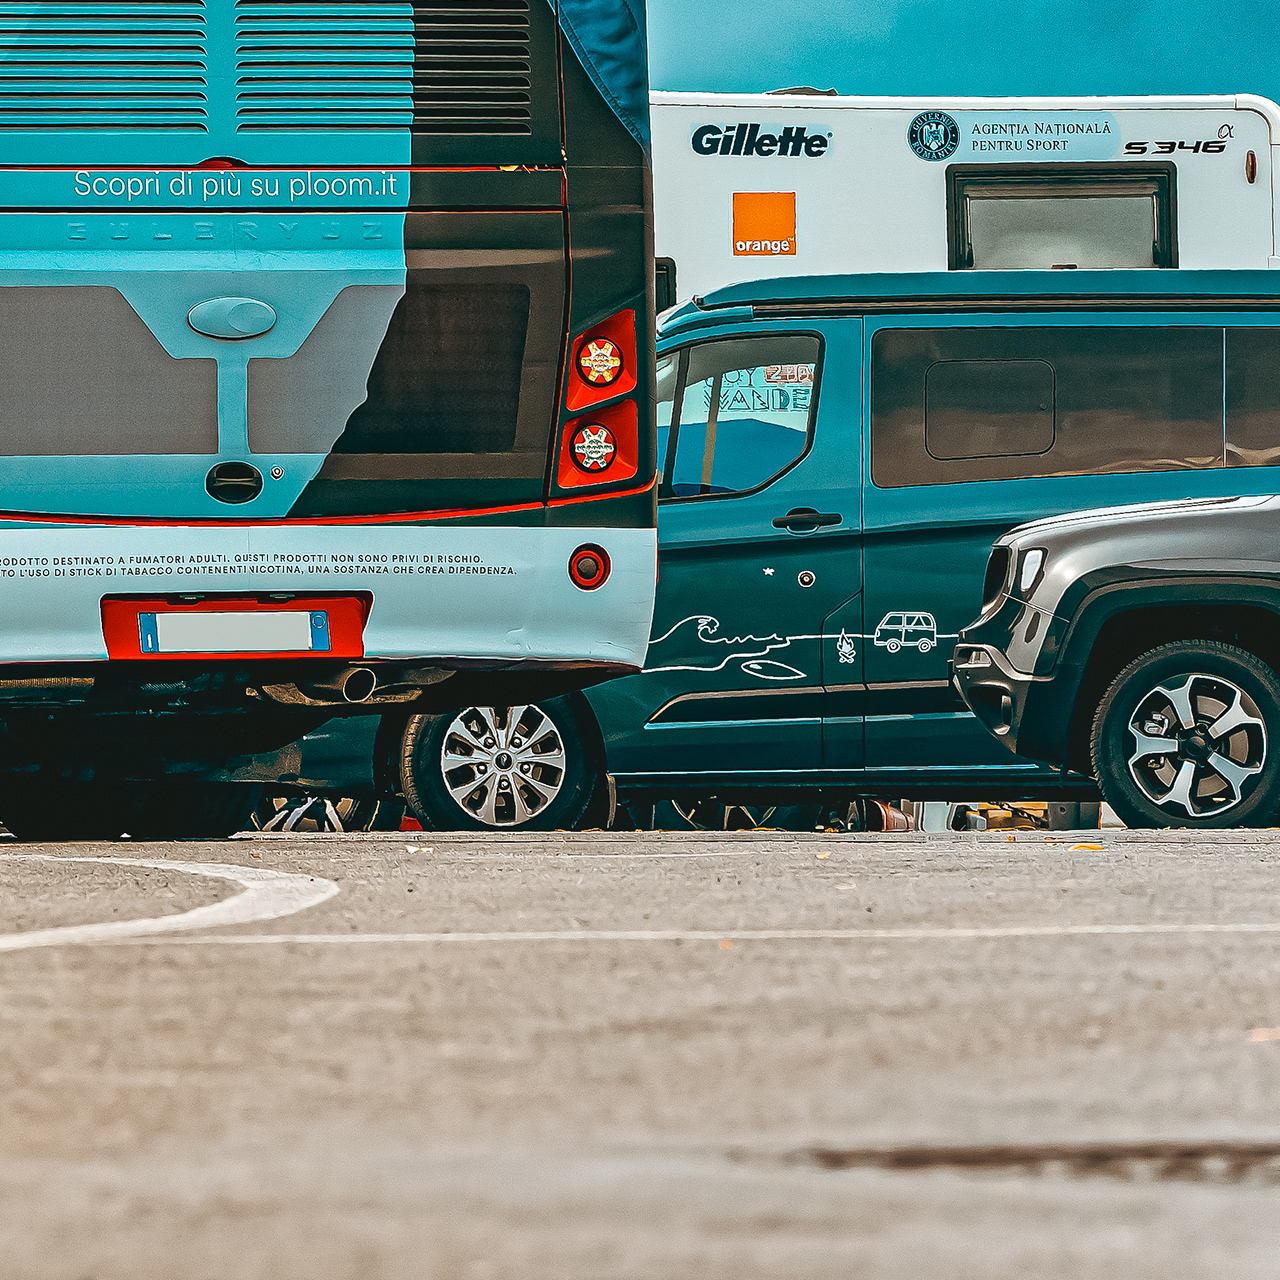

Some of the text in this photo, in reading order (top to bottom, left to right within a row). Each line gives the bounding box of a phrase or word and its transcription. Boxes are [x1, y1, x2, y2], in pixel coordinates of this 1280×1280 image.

[691, 122, 828, 157] Gillette
[73, 170, 398, 202] Scopri di più su ploom.it
[735, 240, 790, 254] orange
[52, 556, 114, 566] DESTINATO
[118, 556, 125, 565] A
[129, 555, 185, 565] FUMATORI
[189, 554, 230, 564] ADULTI.
[234, 554, 269, 563] QUESTI
[273, 554, 327, 563] PRODOTTI
[331, 554, 354, 563] NON
[358, 554, 388, 563] SONO
[392, 554, 419, 563] PRIVI
[423, 554, 433, 564] DI
[437, 554, 484, 564] RISCHIO.
[19, 568, 50, 577] L'USO
[54, 568, 66, 577] DI
[69, 567, 102, 577] STICK
[106, 567, 117, 576] DI
[121, 566, 173, 576] TABACCO
[308, 565, 330, 574] UNA
[333, 565, 389, 574] SOSTANZA
[393, 565, 414, 574] CHE
[417, 565, 445, 574] CREA
[448, 566, 517, 575] DIPENDENZA.
